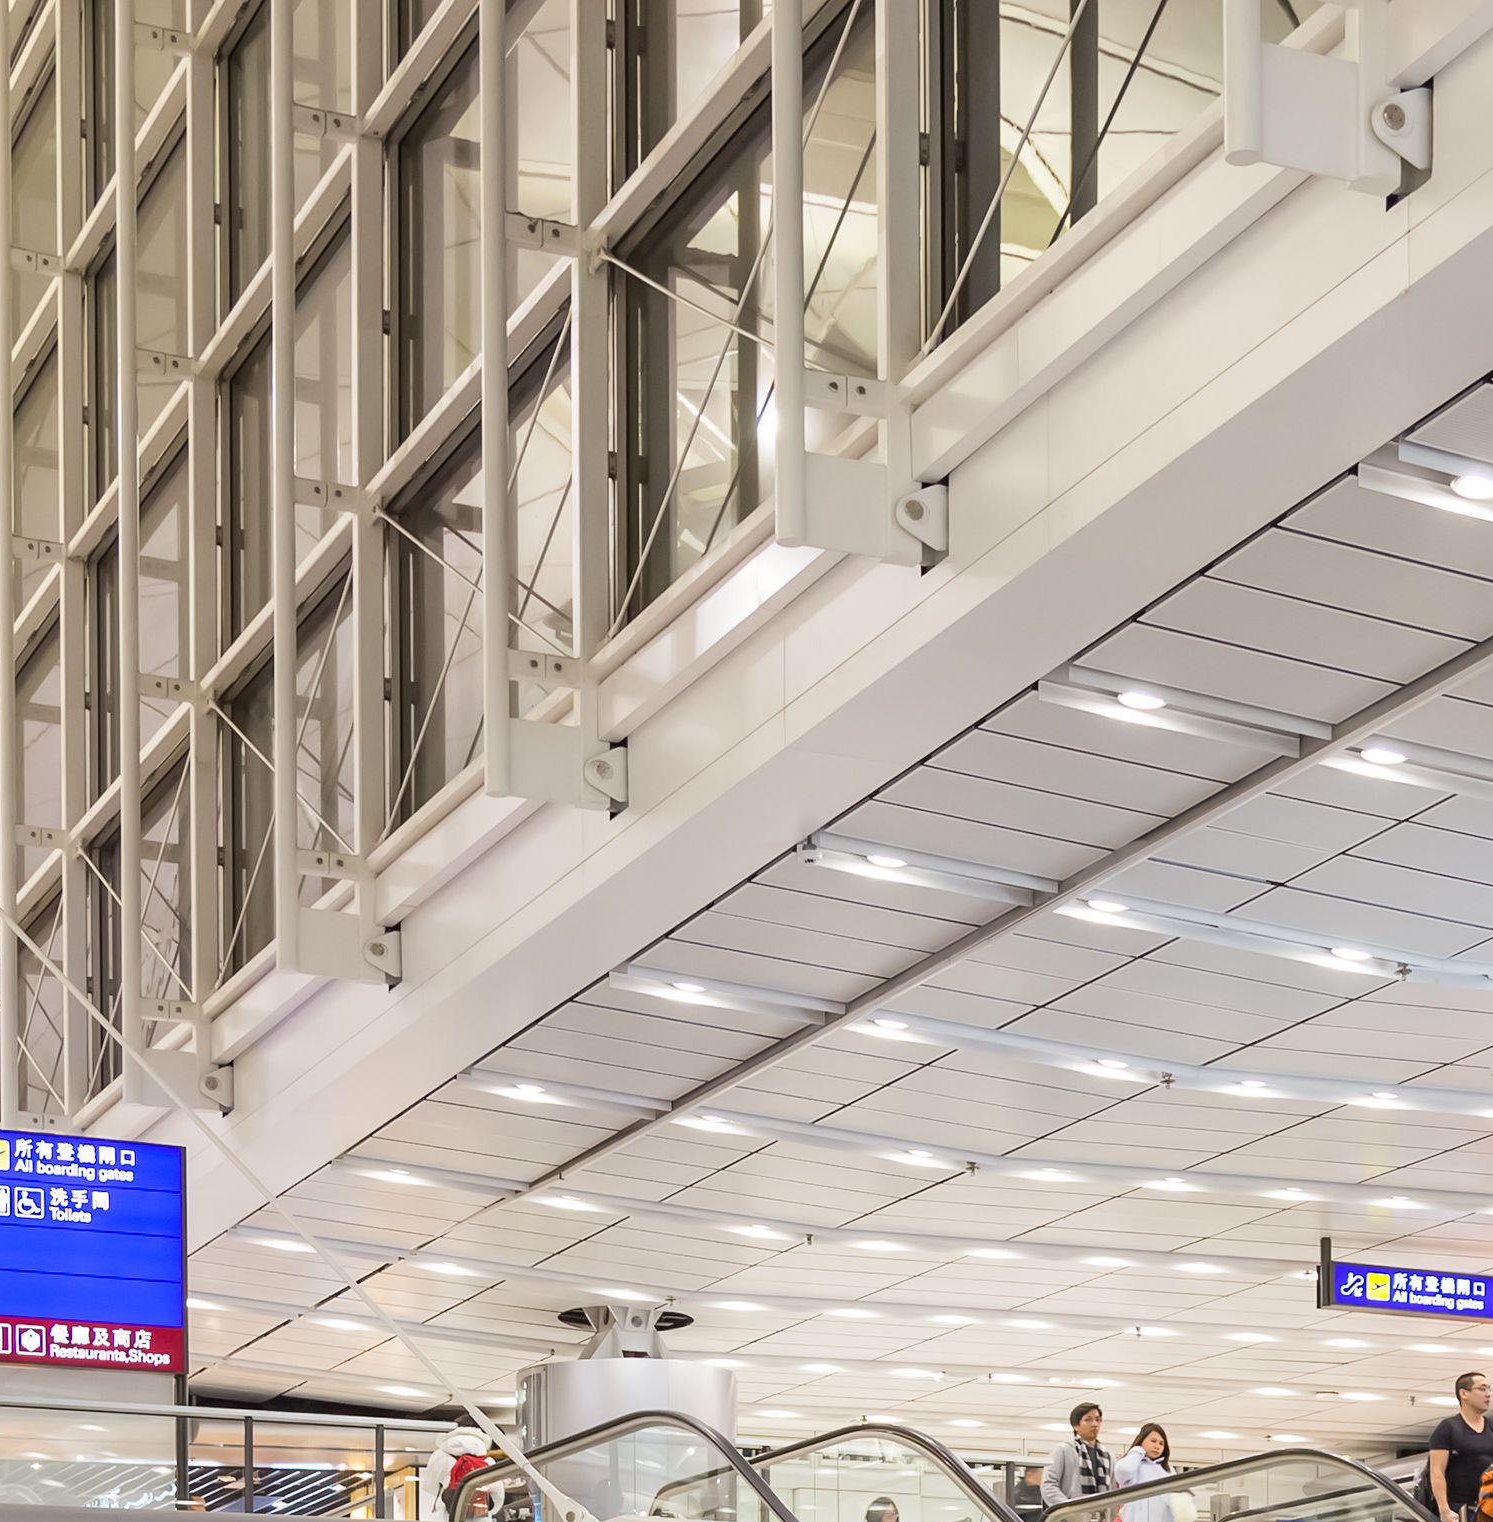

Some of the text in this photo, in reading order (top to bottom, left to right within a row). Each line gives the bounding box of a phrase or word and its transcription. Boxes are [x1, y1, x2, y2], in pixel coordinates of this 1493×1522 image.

[14, 1158, 134, 1182] All boarding gates
[49, 1188, 110, 1211] 洗手間
[49, 1207, 92, 1223] Toilets
[1393, 1291, 1484, 1310] All boarding gates
